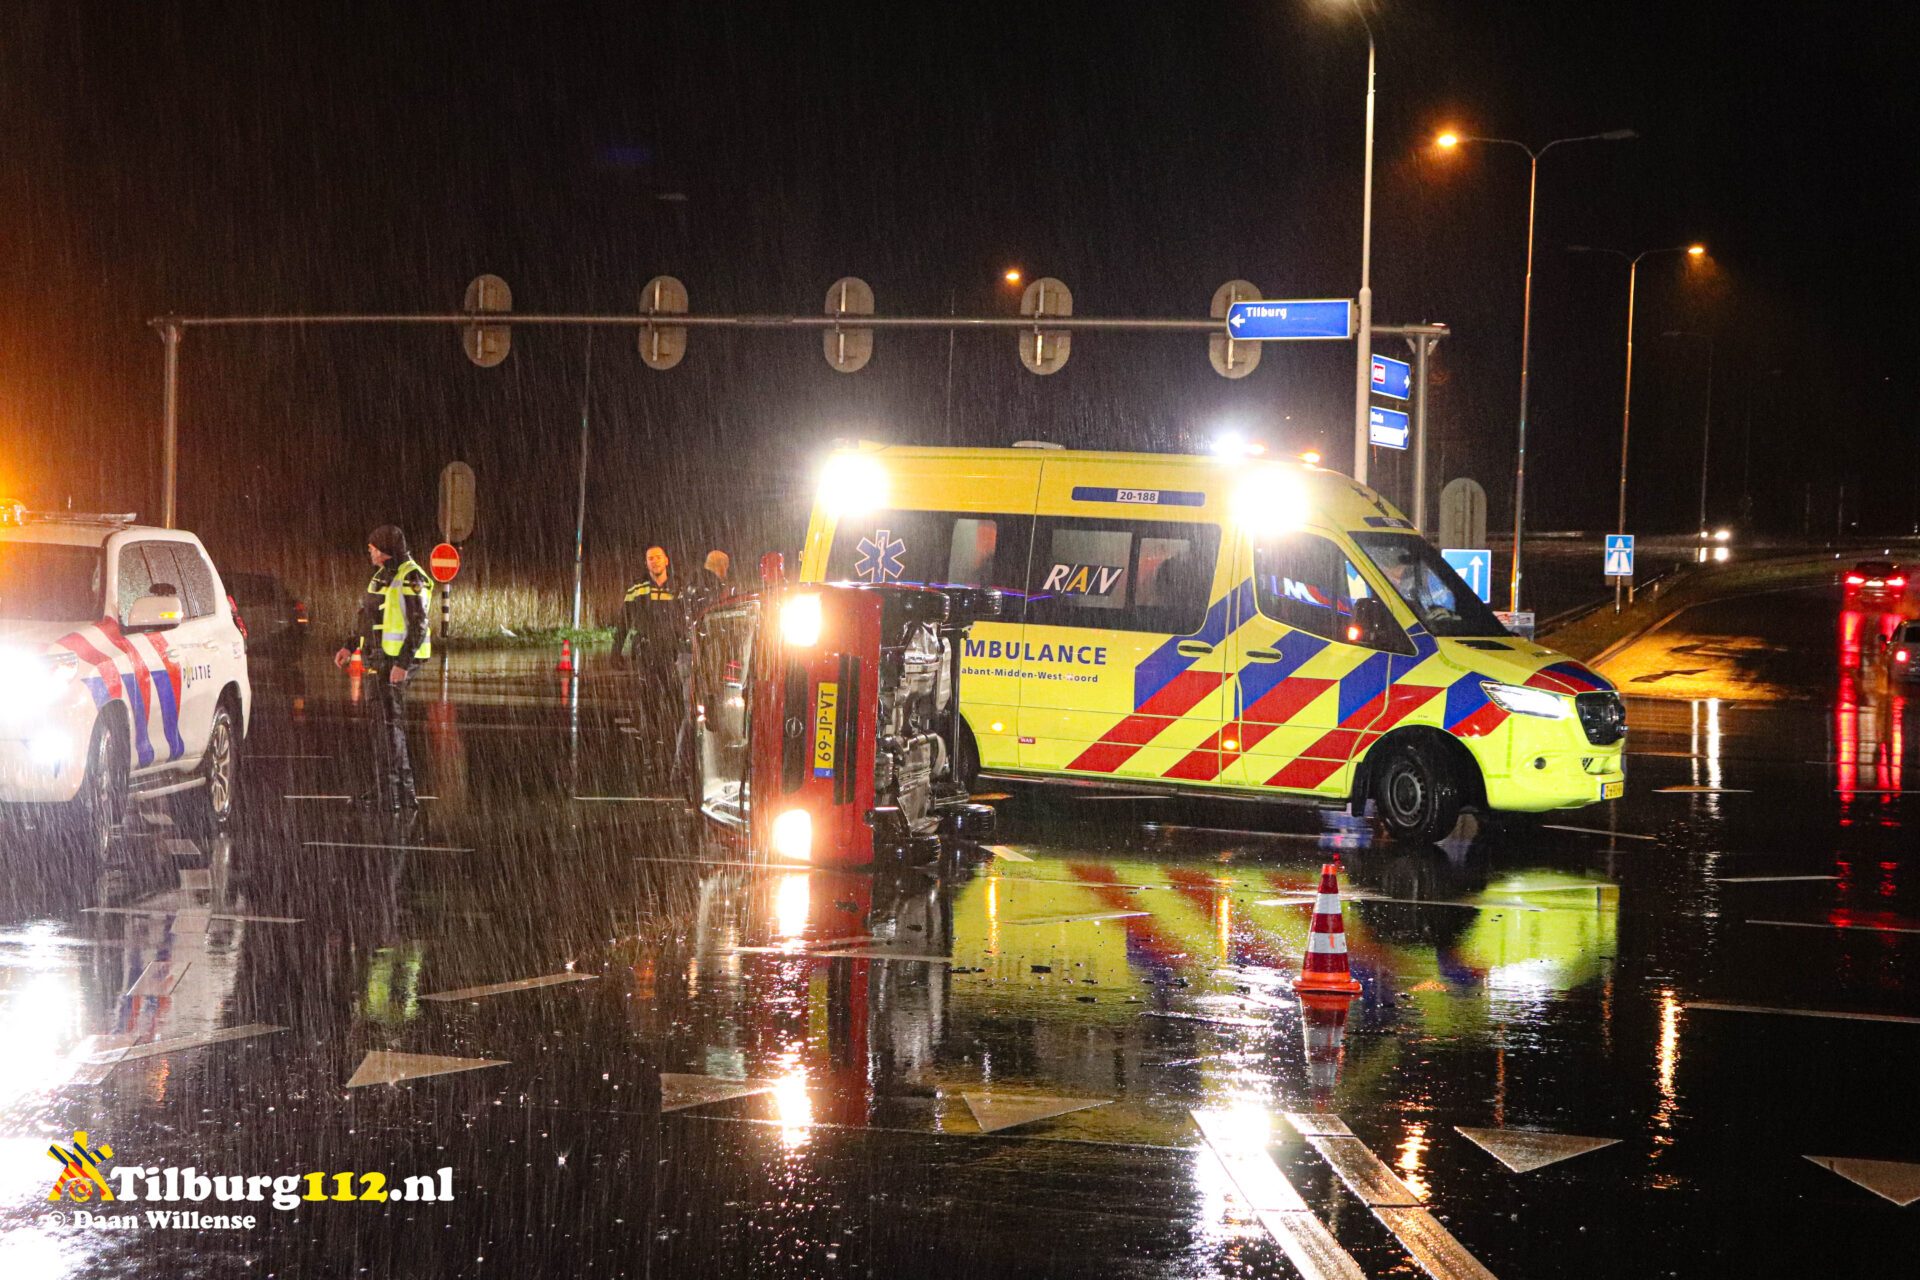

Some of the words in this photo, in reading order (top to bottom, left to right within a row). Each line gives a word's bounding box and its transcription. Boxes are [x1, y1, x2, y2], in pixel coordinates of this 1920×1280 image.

[1245, 306, 1287, 320] Tilburg
[1119, 491, 1156, 501] 20-188
[964, 639, 1107, 665] MBULANCE
[817, 690, 835, 762] 69-JP-VT
